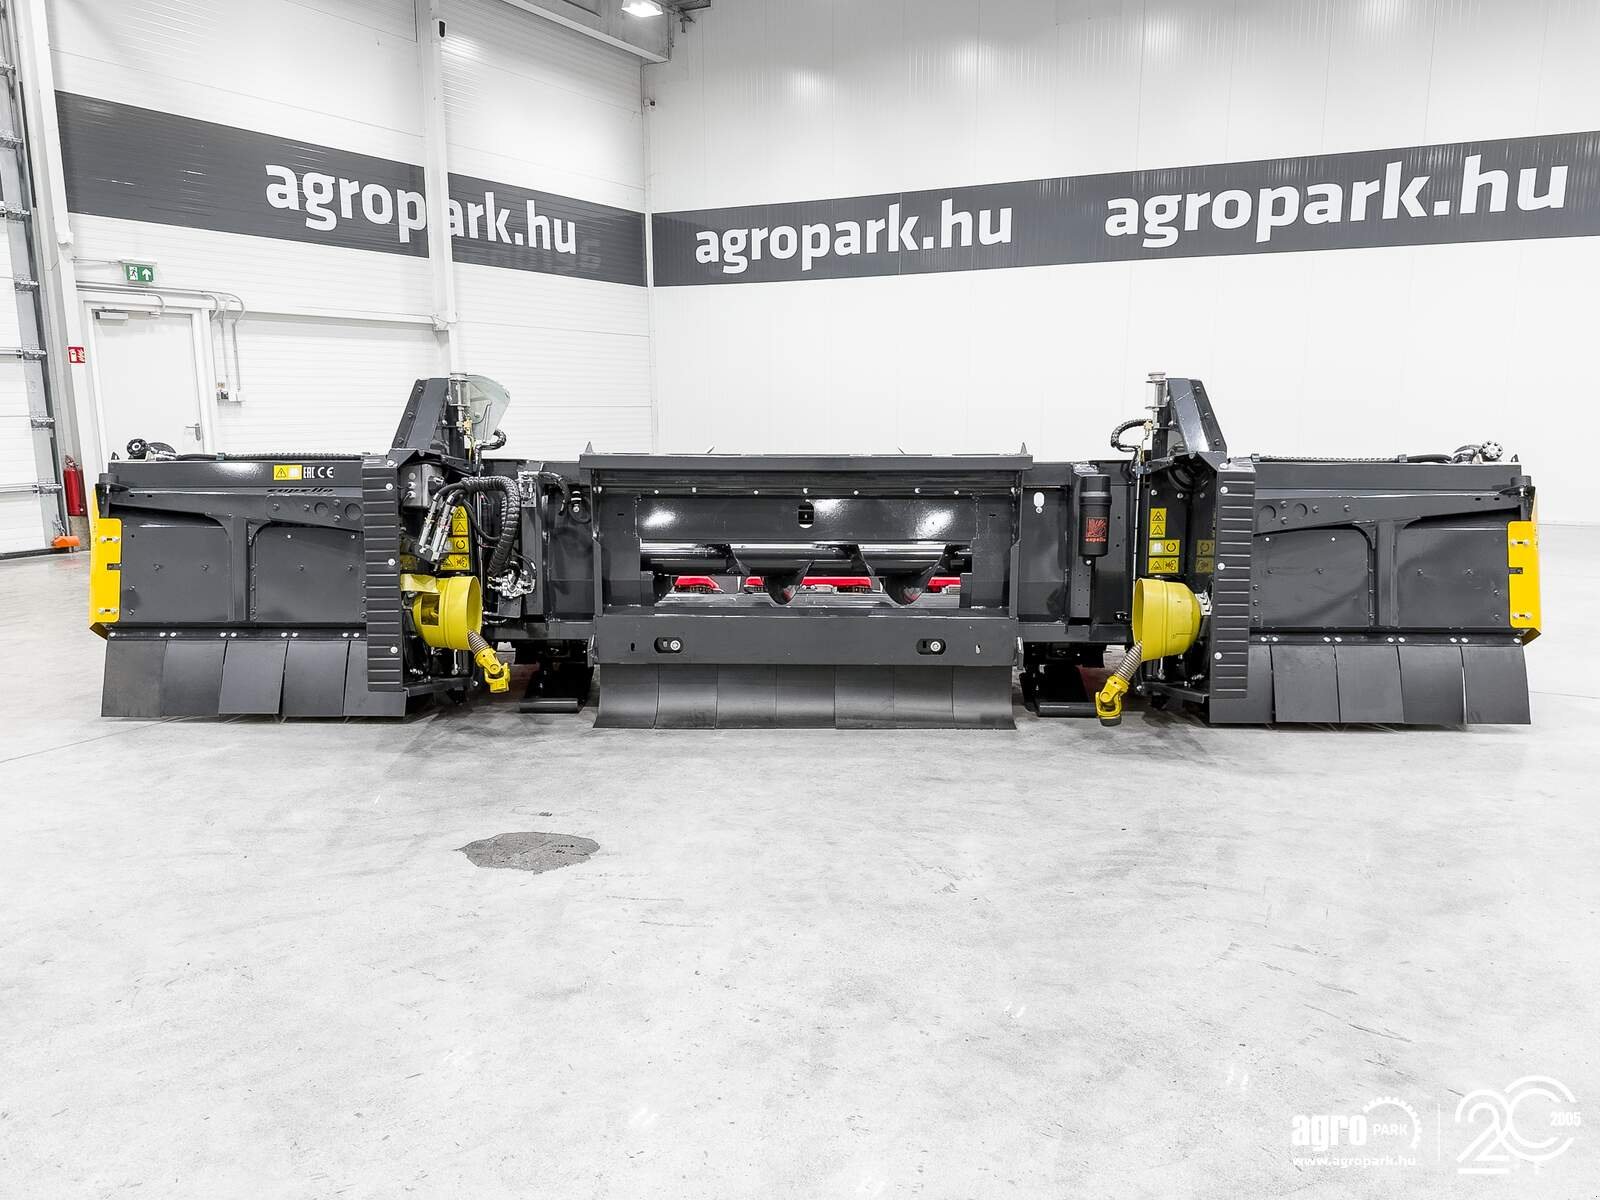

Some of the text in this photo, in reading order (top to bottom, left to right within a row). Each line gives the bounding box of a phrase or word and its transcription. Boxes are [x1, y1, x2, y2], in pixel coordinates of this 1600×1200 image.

[695, 198, 1013, 275] agropark.hu
[1105, 154, 1569, 248] agropark.hu
[317, 466, 335, 479] CE
